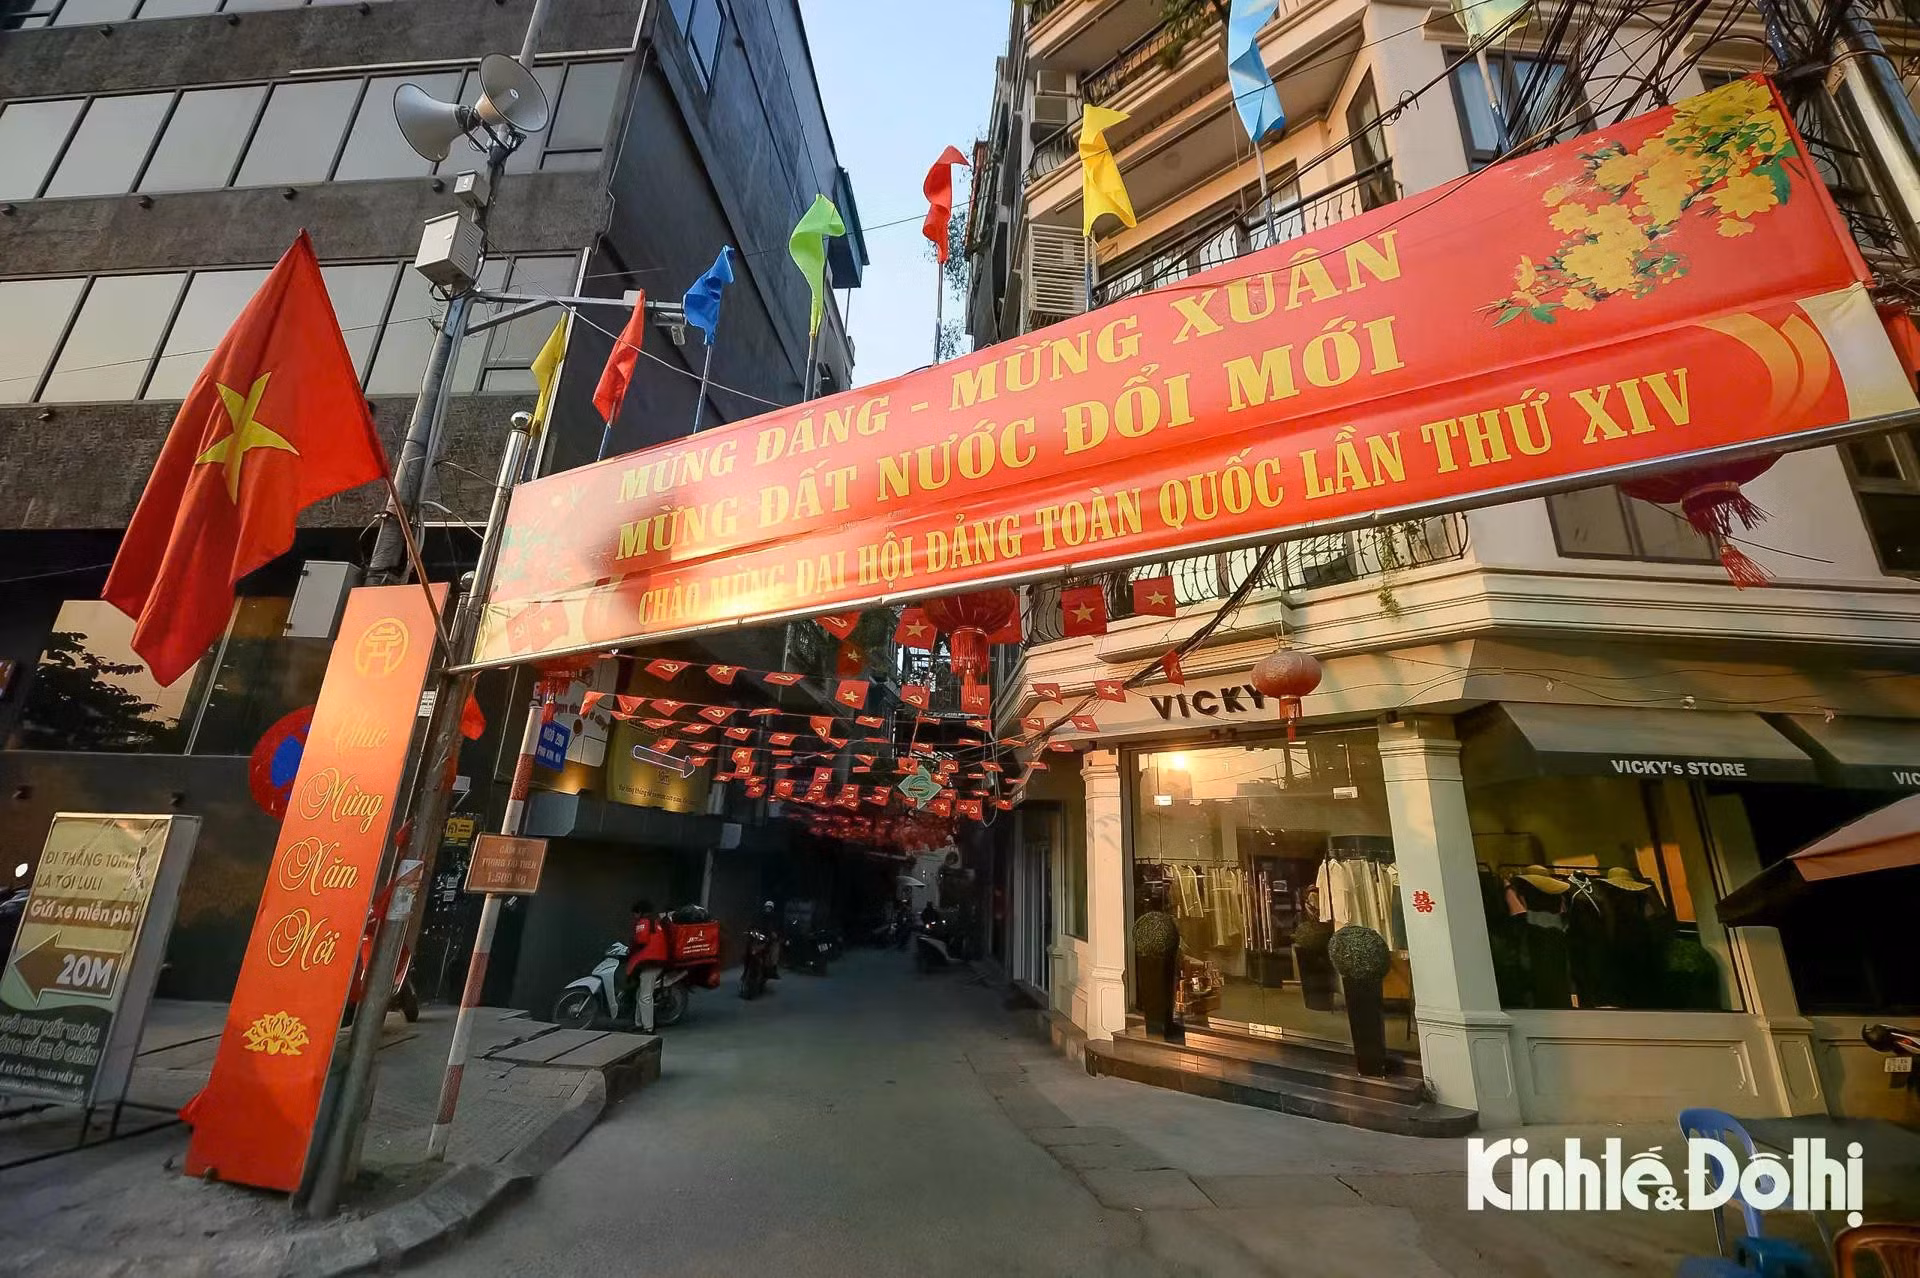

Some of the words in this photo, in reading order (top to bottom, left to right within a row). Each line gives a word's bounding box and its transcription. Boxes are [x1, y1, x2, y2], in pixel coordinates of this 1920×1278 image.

[616, 438, 738, 504] MỪNG
[753, 394, 891, 467] ĐẢNG
[948, 314, 1143, 413] MỪNG
[1169, 228, 1402, 345] XUÂN
[614, 496, 739, 562] MỪNG
[756, 458, 859, 530] ĐẤT
[874, 416, 1037, 503] NƯỚC
[1061, 362, 1196, 456] ĐỔI
[1222, 315, 1406, 413] MỚI
[638, 577, 702, 627] CHÀO
[856, 530, 915, 590] HỘI
[925, 512, 1024, 575] ĐẢNG
[1035, 486, 1145, 553] TOÀN
[1158, 447, 1286, 531] QUỐC
[1299, 425, 1408, 501] LẦN
[1420, 387, 1553, 474] THỨ
[1569, 367, 1691, 445] XIV
[1611, 760, 1684, 775] VICKY's
[1689, 762, 1748, 777] STORE
[1892, 771, 1920, 785] VIC
[300, 767, 385, 834] Mừng
[45, 851, 59, 865] ĐI
[278, 836, 361, 897] Năm
[54, 904, 74, 921] xe
[110, 903, 139, 928] phí
[267, 907, 341, 972] Mới
[56, 953, 114, 989] 20M
